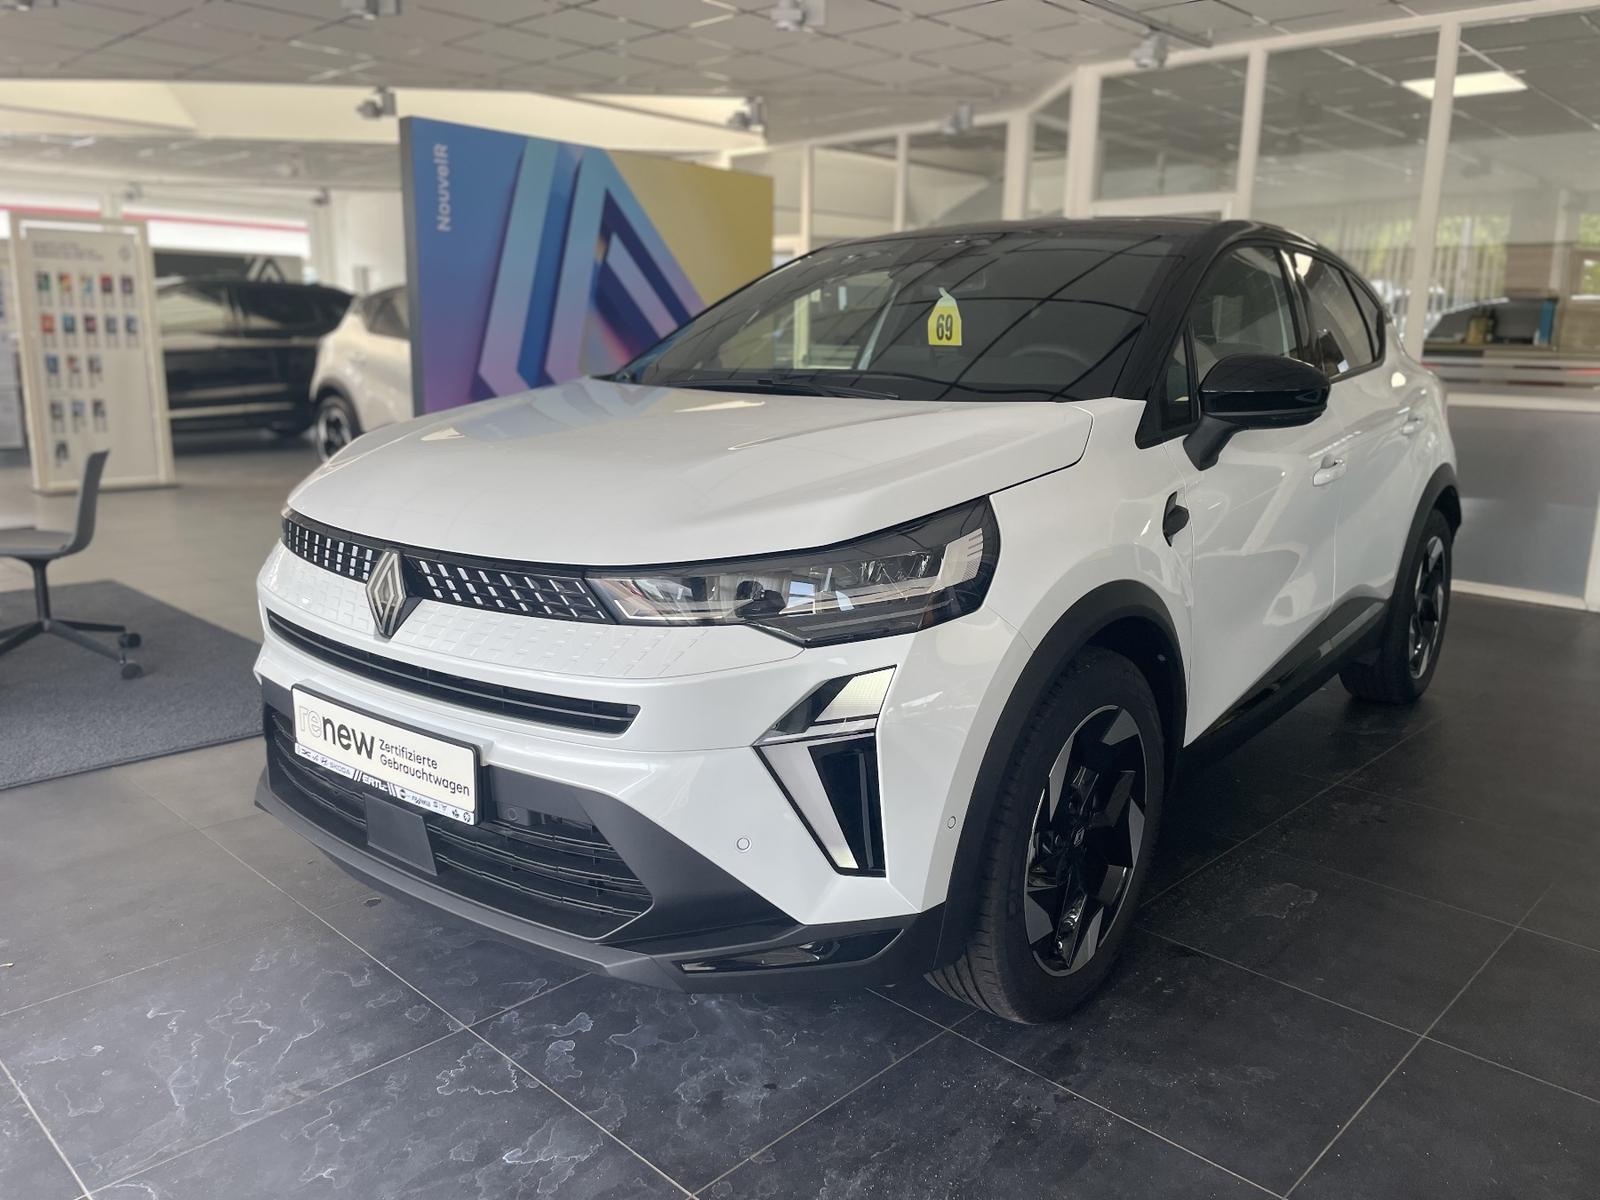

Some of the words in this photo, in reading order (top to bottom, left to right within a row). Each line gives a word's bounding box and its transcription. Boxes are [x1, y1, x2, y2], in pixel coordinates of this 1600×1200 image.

[936, 313, 953, 341] 69
[299, 705, 375, 760] renew
[379, 738, 438, 770] Zertifizierte
[379, 754, 471, 797] Gebrauchtwagen
